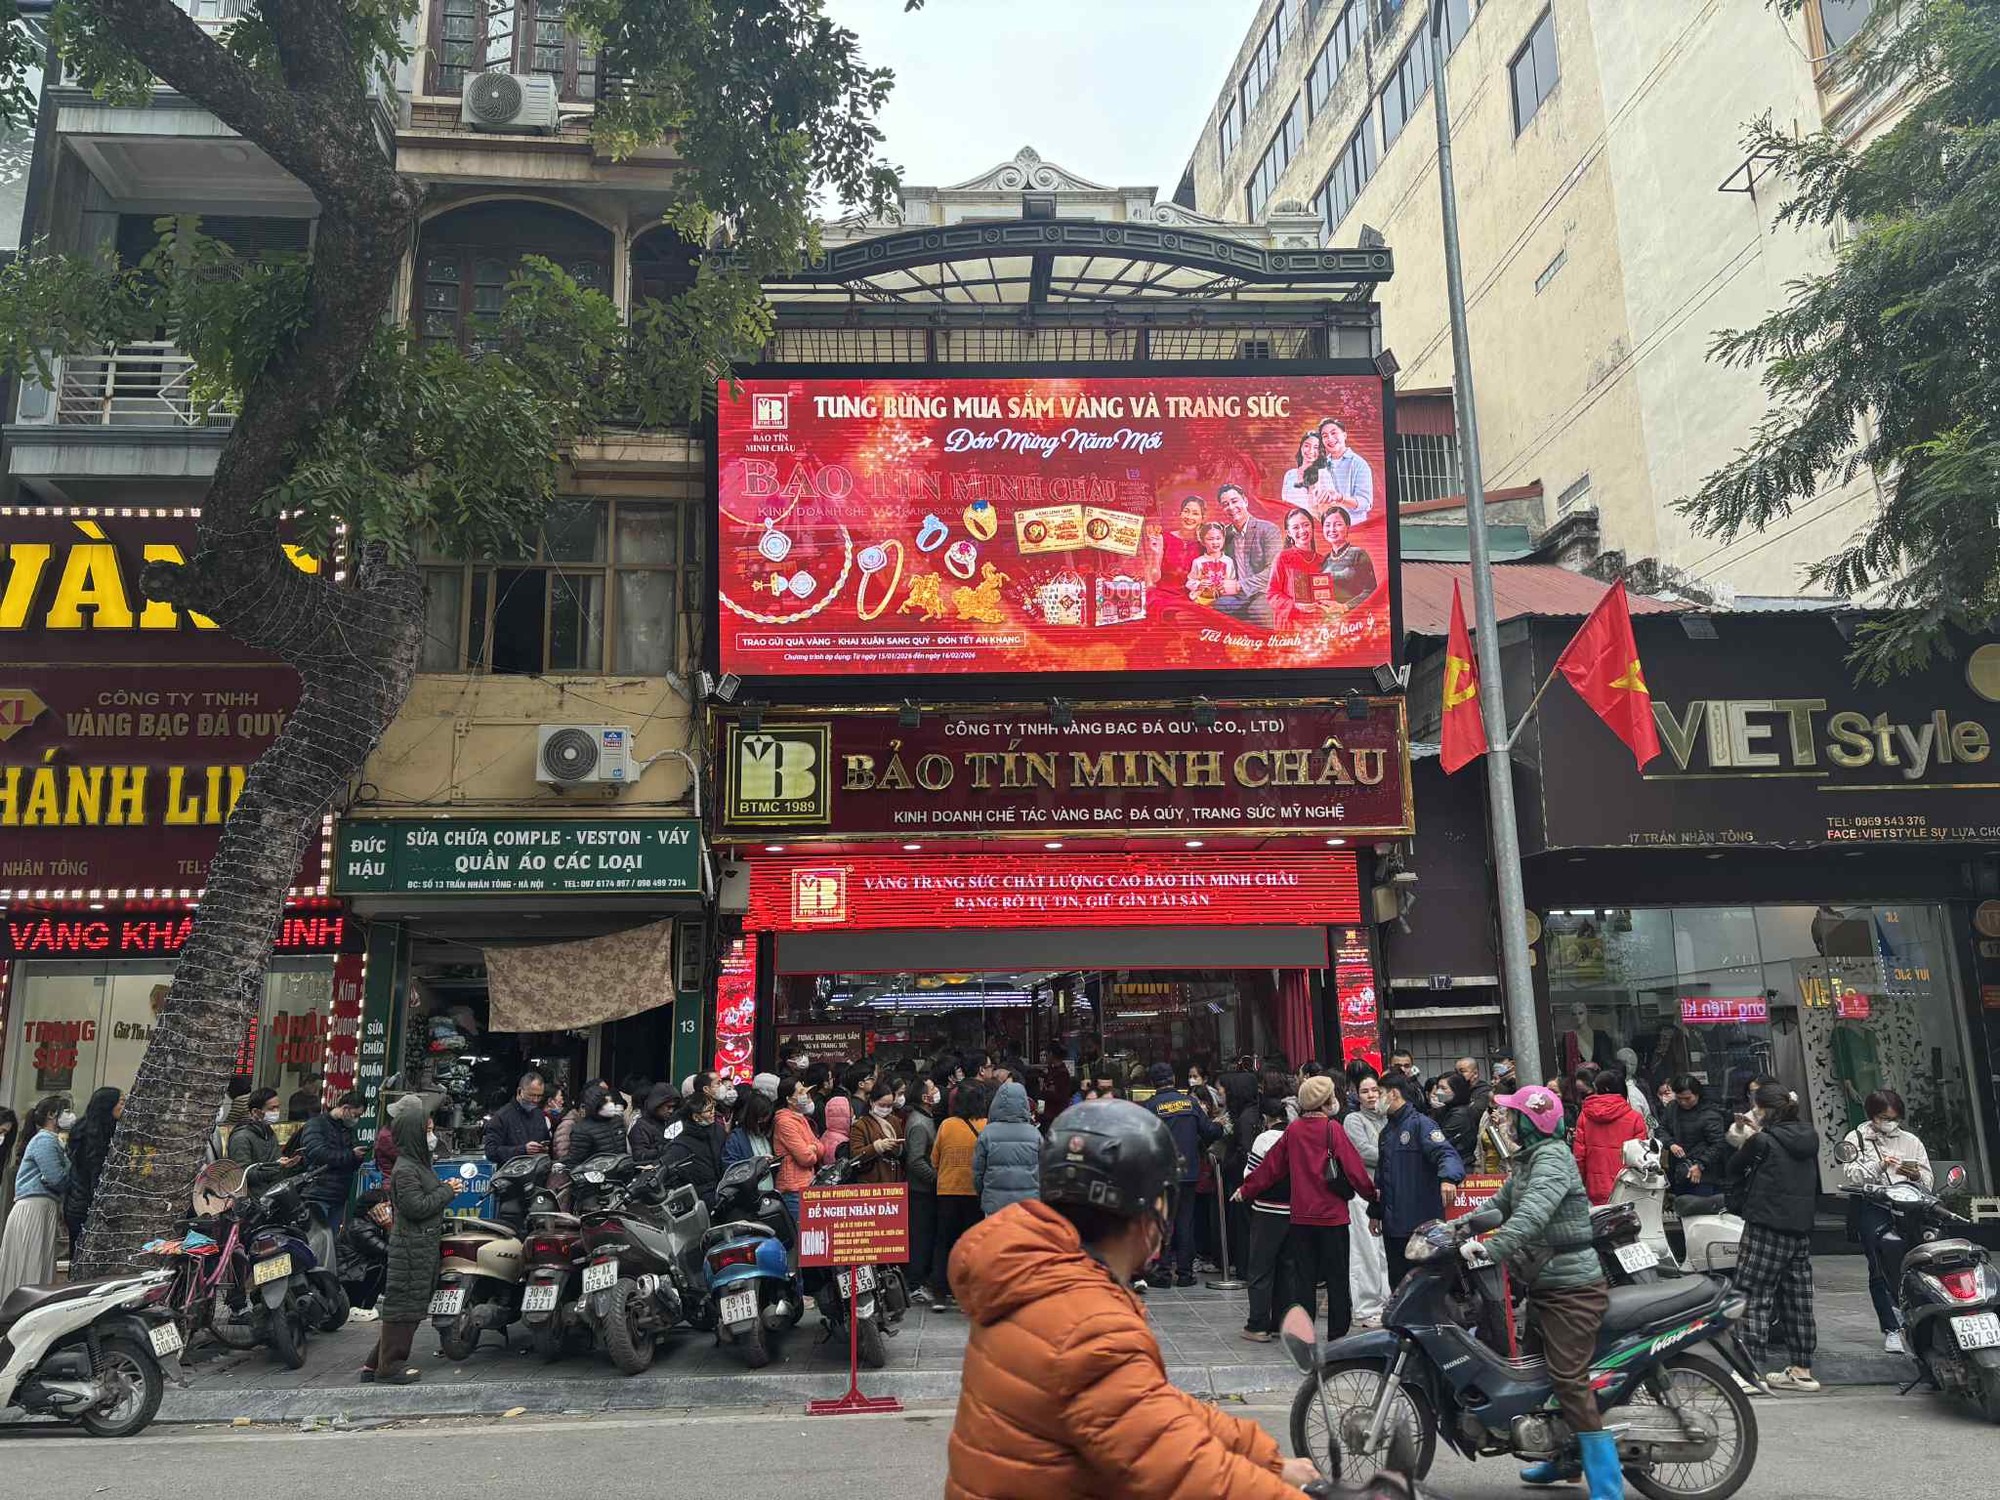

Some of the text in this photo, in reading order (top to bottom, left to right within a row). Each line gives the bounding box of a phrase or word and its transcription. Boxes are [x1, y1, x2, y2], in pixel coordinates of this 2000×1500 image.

[953, 396, 1003, 419] MUA
[1008, 389, 1057, 419] SẮM
[1061, 392, 1125, 419] VÀNG
[1129, 392, 1162, 419] VÀ
[1165, 395, 1242, 418] TRANG
[1247, 391, 1291, 418] SỨC
[944, 428, 1163, 459] Đón Mừng Năm Mới
[838, 637, 859, 646] KHAI
[886, 637, 910, 645] SANG
[976, 636, 988, 645] AN
[989, 636, 1021, 645] KHANG
[98, 689, 259, 706] CÔNG TY TNHH
[66, 706, 288, 741] VÀNG BẠC ĐÁ QUÝ
[945, 721, 991, 737] CÔNG
[992, 724, 1013, 736] TY
[1105, 722, 1137, 737] BẠC
[1142, 719, 1165, 735] ĐÁ
[1250, 718, 1285, 734] LTD)
[1651, 698, 1828, 771] VIET
[841, 734, 1388, 791] BẢO TÍN MINH CHÂU
[740, 801, 816, 813] BTMC 1989
[894, 803, 1345, 823] KINH DOANH CHẾ TÁC VÀNG BẠC ĐÁ TRANG SỨC MỸ NGHỆ
[1827, 815, 1927, 828] TEL: 0969 543 376
[406, 825, 691, 846] SỬA CHỮA COMPLE VESTON VÁY
[1681, 829, 1715, 843] NHÂN
[1719, 829, 1755, 842] TÔNG
[1930, 827, 1977, 841] SỰ LỰA
[350, 836, 387, 854] ĐỨC
[2, 858, 44, 877] NHÂN
[50, 858, 89, 877] TÔNG
[348, 860, 386, 880] HẬU
[454, 850, 644, 873] QUẦN ÁO CÁC LOẠI
[518, 878, 529, 889] HÀ
[530, 878, 545, 891] NỘI
[864, 875, 908, 890] VÀNG
[912, 876, 965, 889] TRANG
[968, 873, 998, 888] SỨC
[1107, 875, 1142, 886] CAO
[1210, 873, 1251, 886] MINH
[1255, 869, 1300, 886] CHÂU
[9, 918, 110, 950] VÀNG
[338, 979, 357, 1001] Kim
[1434, 975, 1449, 989] 17
[23, 1020, 97, 1043] TRANG
[367, 1018, 385, 1036] SỬA
[680, 1019, 696, 1034] 13
[362, 1041, 385, 1055] CHỮA
[364, 1082, 377, 1098] ÁO
[821, 1190, 832, 1198] AN
[822, 1206, 847, 1219] NGHỊ
[849, 1202, 877, 1216] NHÂN
[878, 1201, 899, 1215] DÂN
[801, 1227, 826, 1256] KHÔNG
[585, 1275, 616, 1292] 029.48
[430, 1302, 456, 1313] 3030
[525, 1298, 552, 1310] 6321
[1442, 1354, 1471, 1372] HONDA
